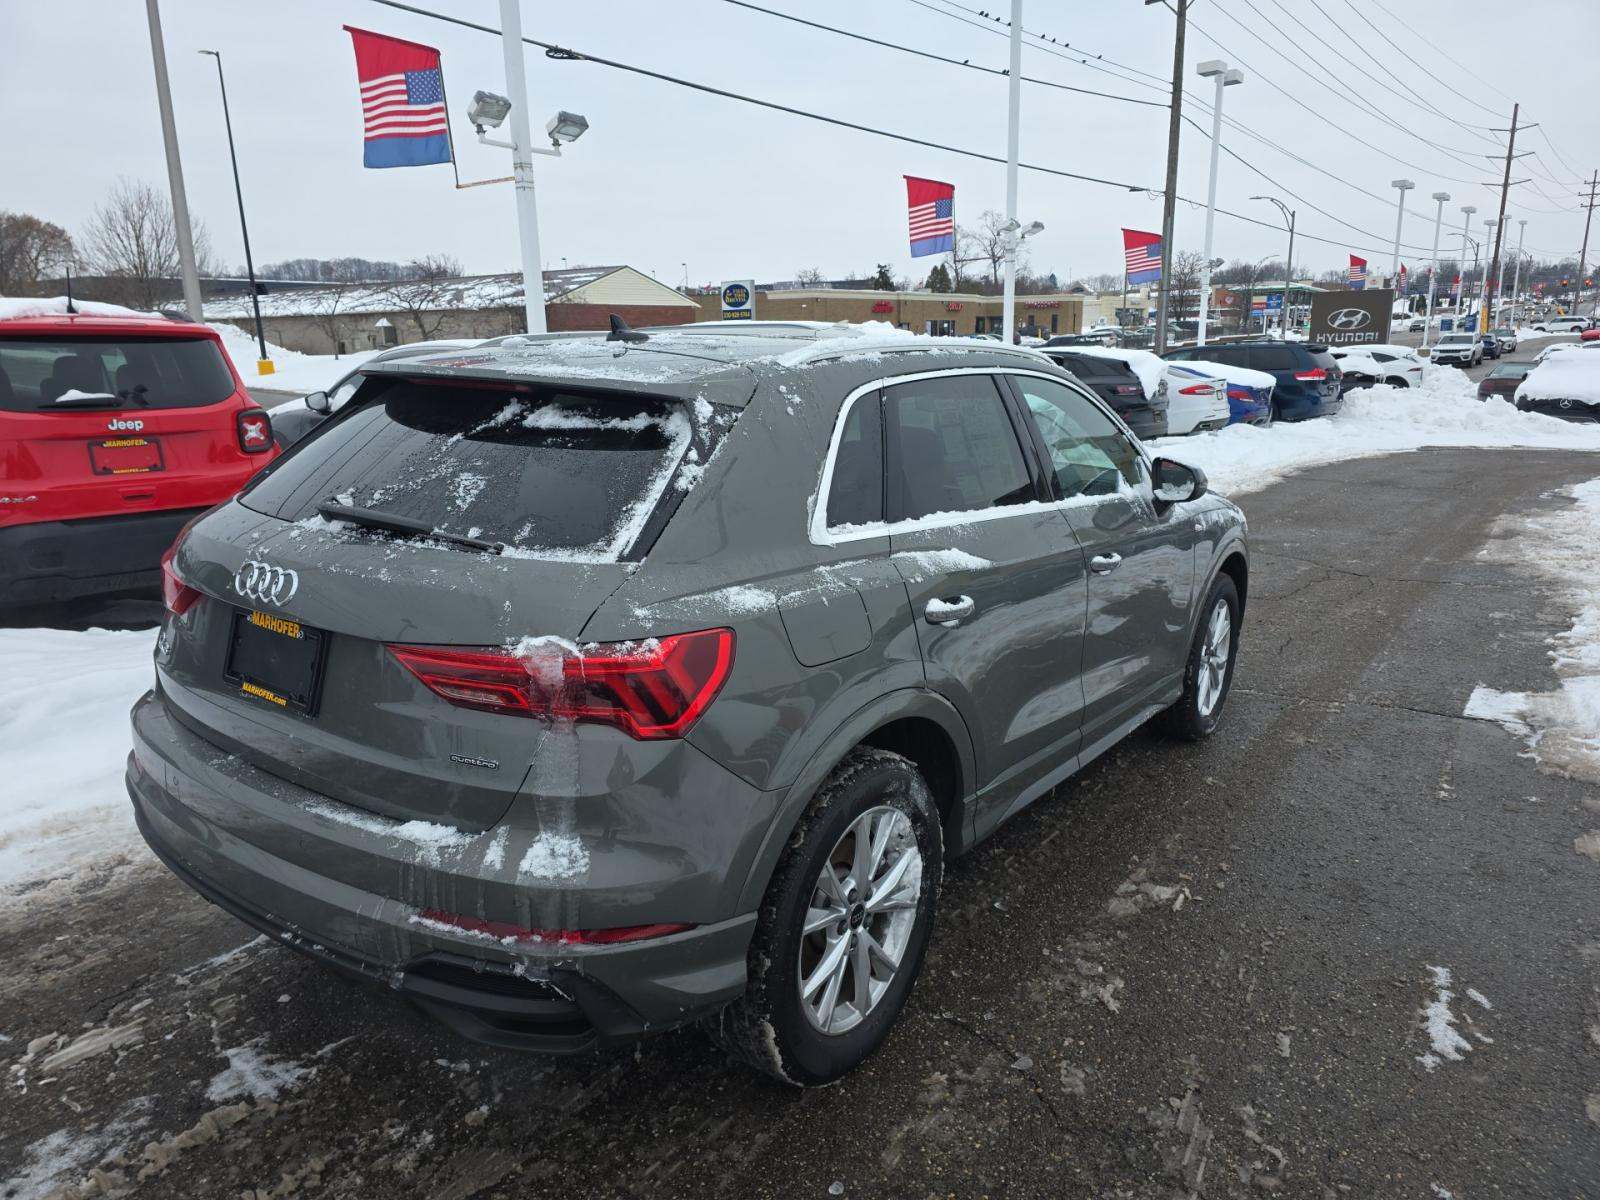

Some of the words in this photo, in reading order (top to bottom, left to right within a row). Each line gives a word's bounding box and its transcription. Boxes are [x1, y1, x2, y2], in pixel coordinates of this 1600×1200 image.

[1316, 332, 1379, 342] HYUNDAI
[108, 418, 144, 431] Jeep
[105, 439, 145, 447] MARHOFER
[252, 610, 300, 638] MARHOFER
[242, 682, 287, 706] MARHOFER.com
[451, 754, 497, 769] quattro
